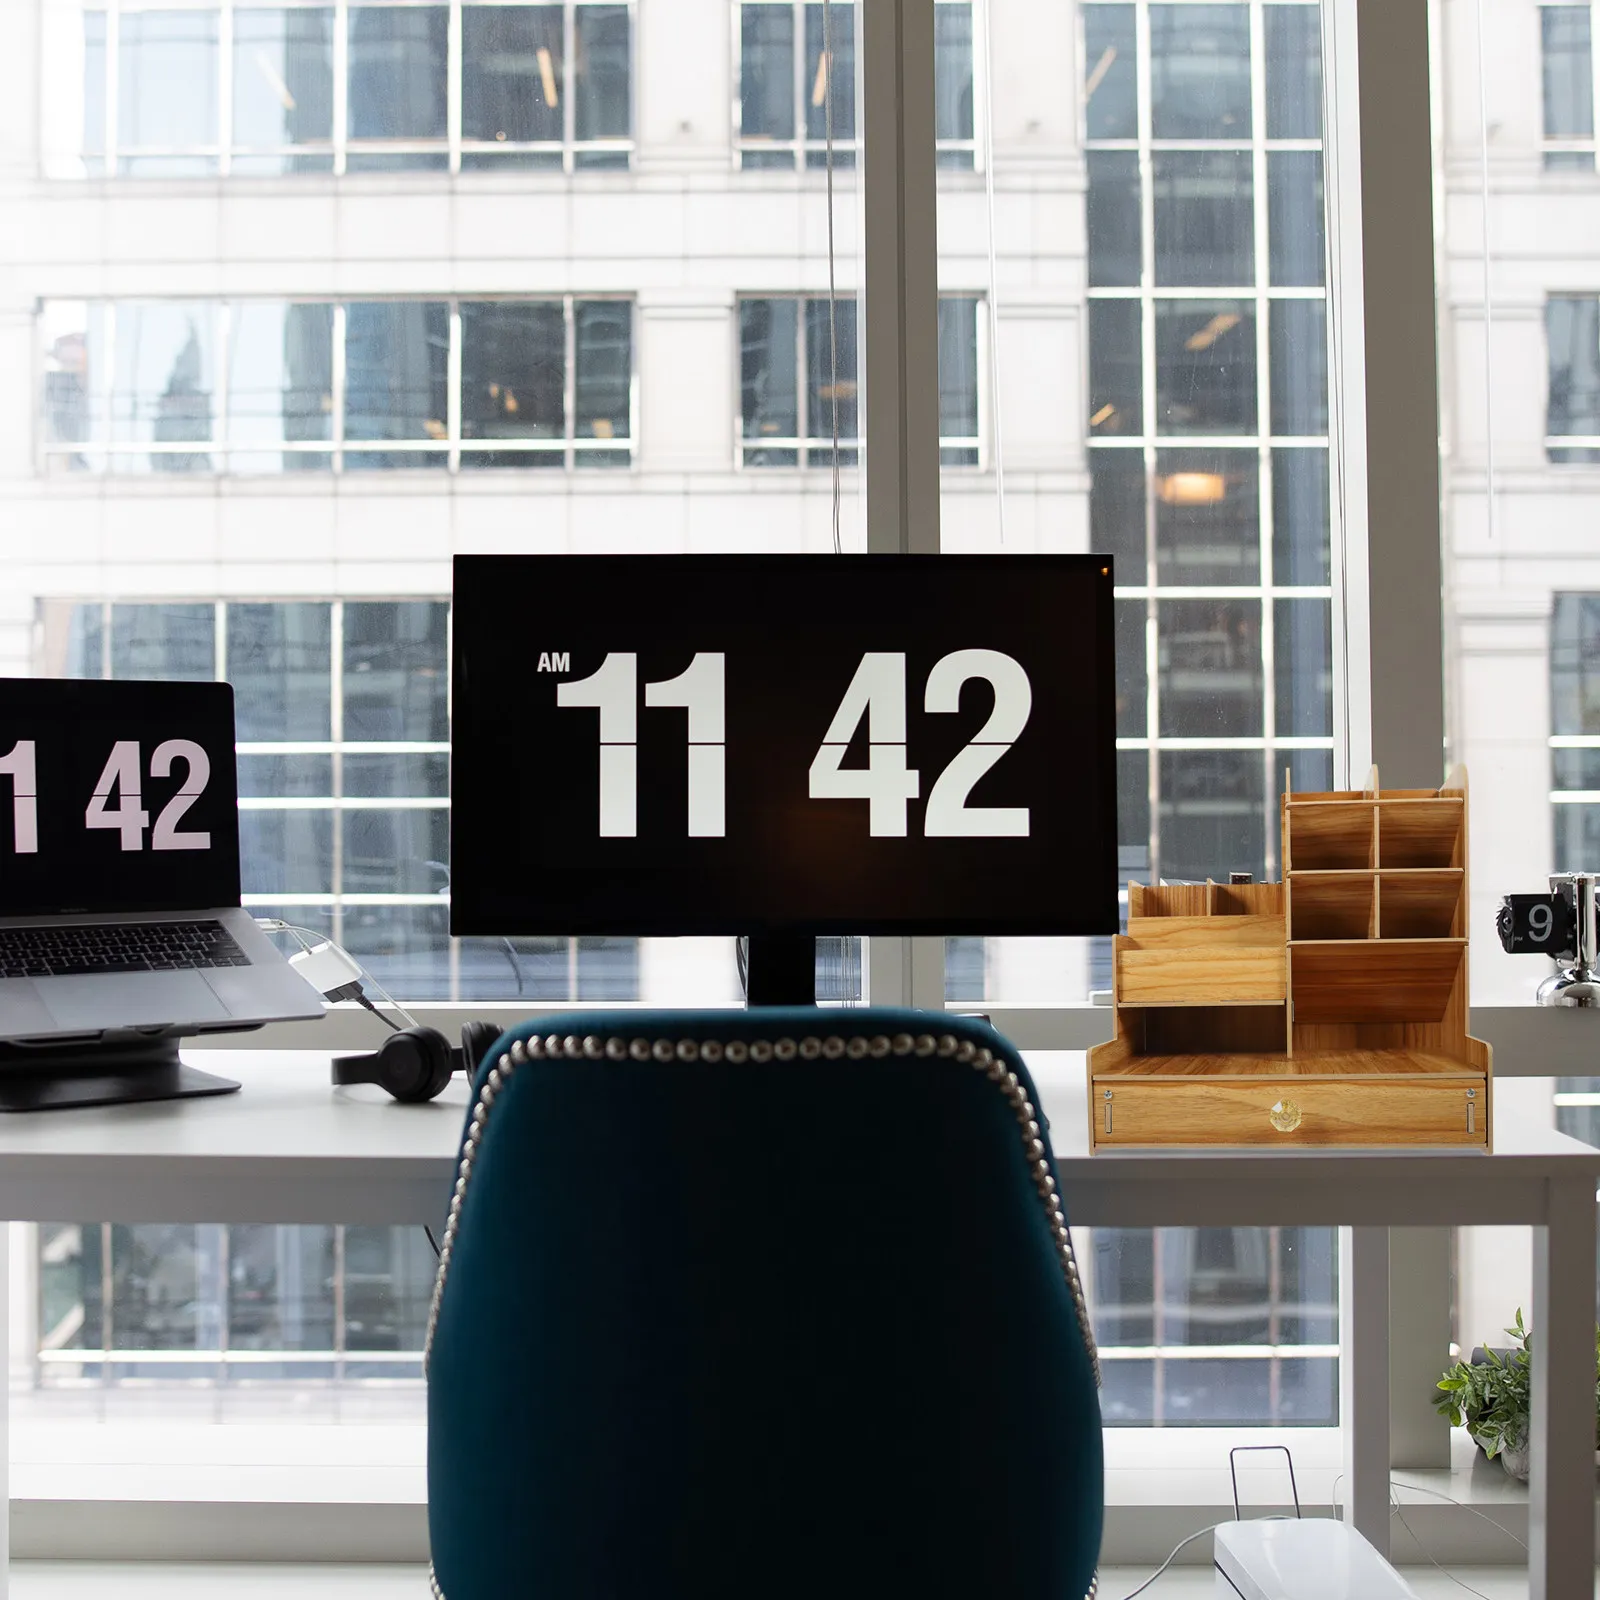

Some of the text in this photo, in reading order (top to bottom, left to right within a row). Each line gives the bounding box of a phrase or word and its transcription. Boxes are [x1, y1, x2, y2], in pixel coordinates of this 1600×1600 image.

[85, 738, 211, 851] 42
[537, 648, 1033, 838] AM 11 42
[1528, 904, 1553, 942] 9
